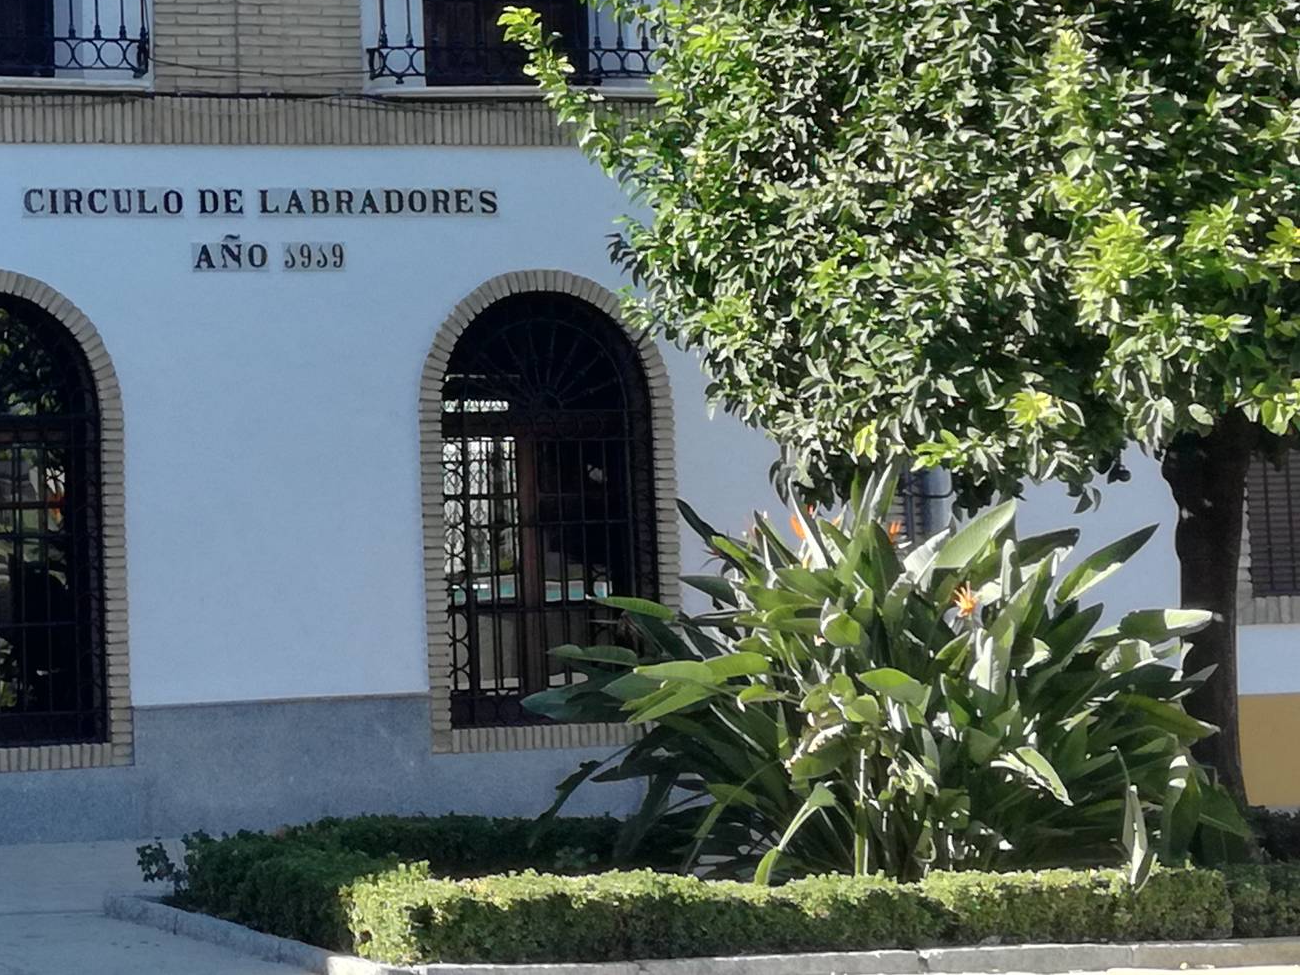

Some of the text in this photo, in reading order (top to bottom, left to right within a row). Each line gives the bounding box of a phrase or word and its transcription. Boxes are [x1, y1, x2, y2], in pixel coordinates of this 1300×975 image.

[23, 188, 499, 215] CIRCULO DE LABRADORES
[193, 234, 268, 269] AÑO
